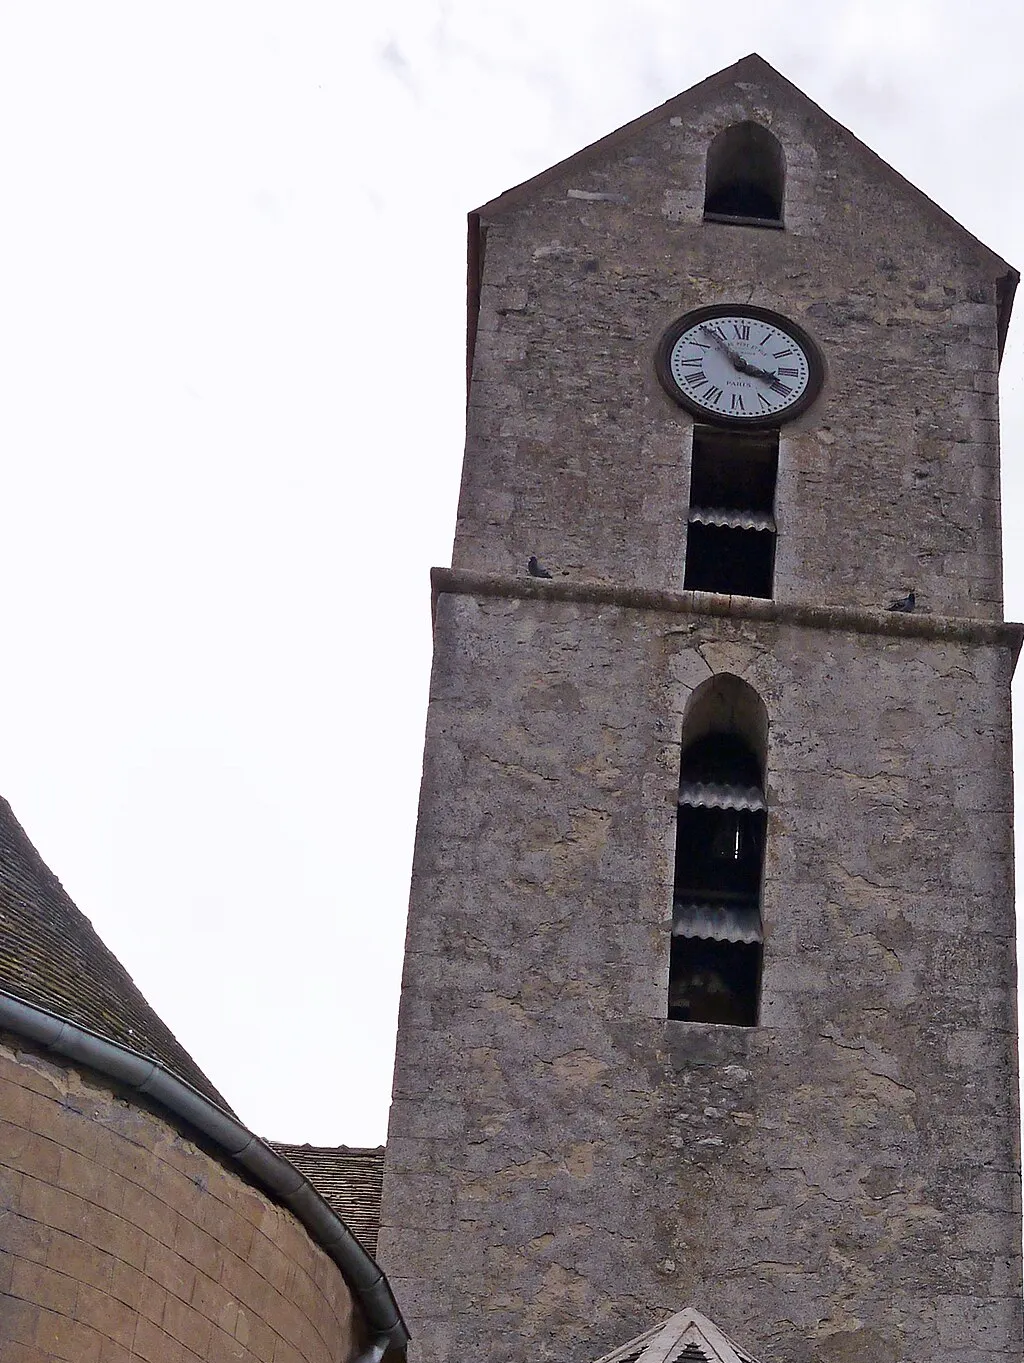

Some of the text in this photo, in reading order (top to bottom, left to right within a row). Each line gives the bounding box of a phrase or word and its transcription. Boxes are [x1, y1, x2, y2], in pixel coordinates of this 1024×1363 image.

[733, 324, 750, 340] XII
[760, 333, 772, 345] I
[689, 337, 711, 353] X
[773, 349, 793, 359] II
[681, 357, 704, 368] IX
[685, 371, 709, 389] VIII
[778, 367, 799, 378] III
[726, 380, 752, 388] PARIS
[702, 385, 724, 404] VII
[731, 393, 745, 411] VI
[756, 392, 772, 409] V
